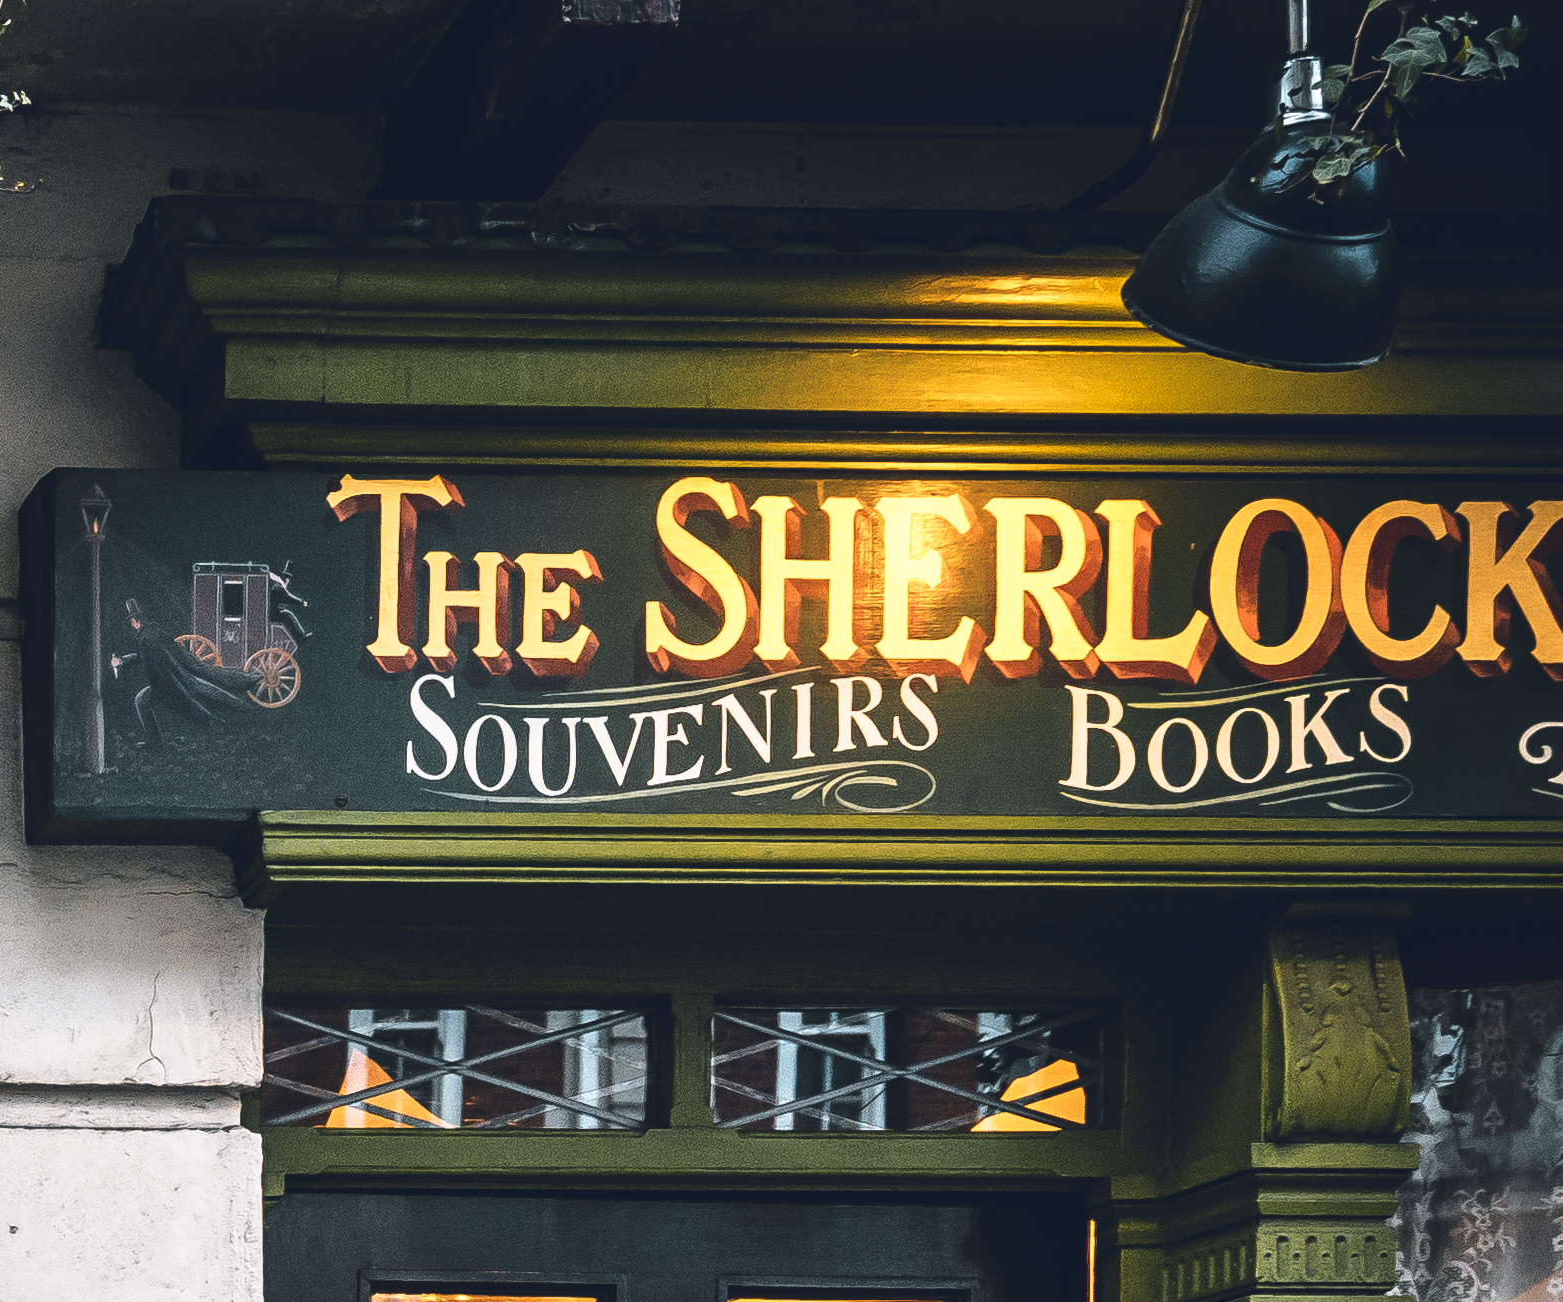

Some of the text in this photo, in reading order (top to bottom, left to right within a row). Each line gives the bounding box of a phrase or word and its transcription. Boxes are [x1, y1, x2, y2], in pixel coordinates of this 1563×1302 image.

[326, 474, 1563, 682] THE SHERLOCK
[405, 673, 940, 797] SOUVENIRS
[1058, 683, 1413, 794] BOOKS
